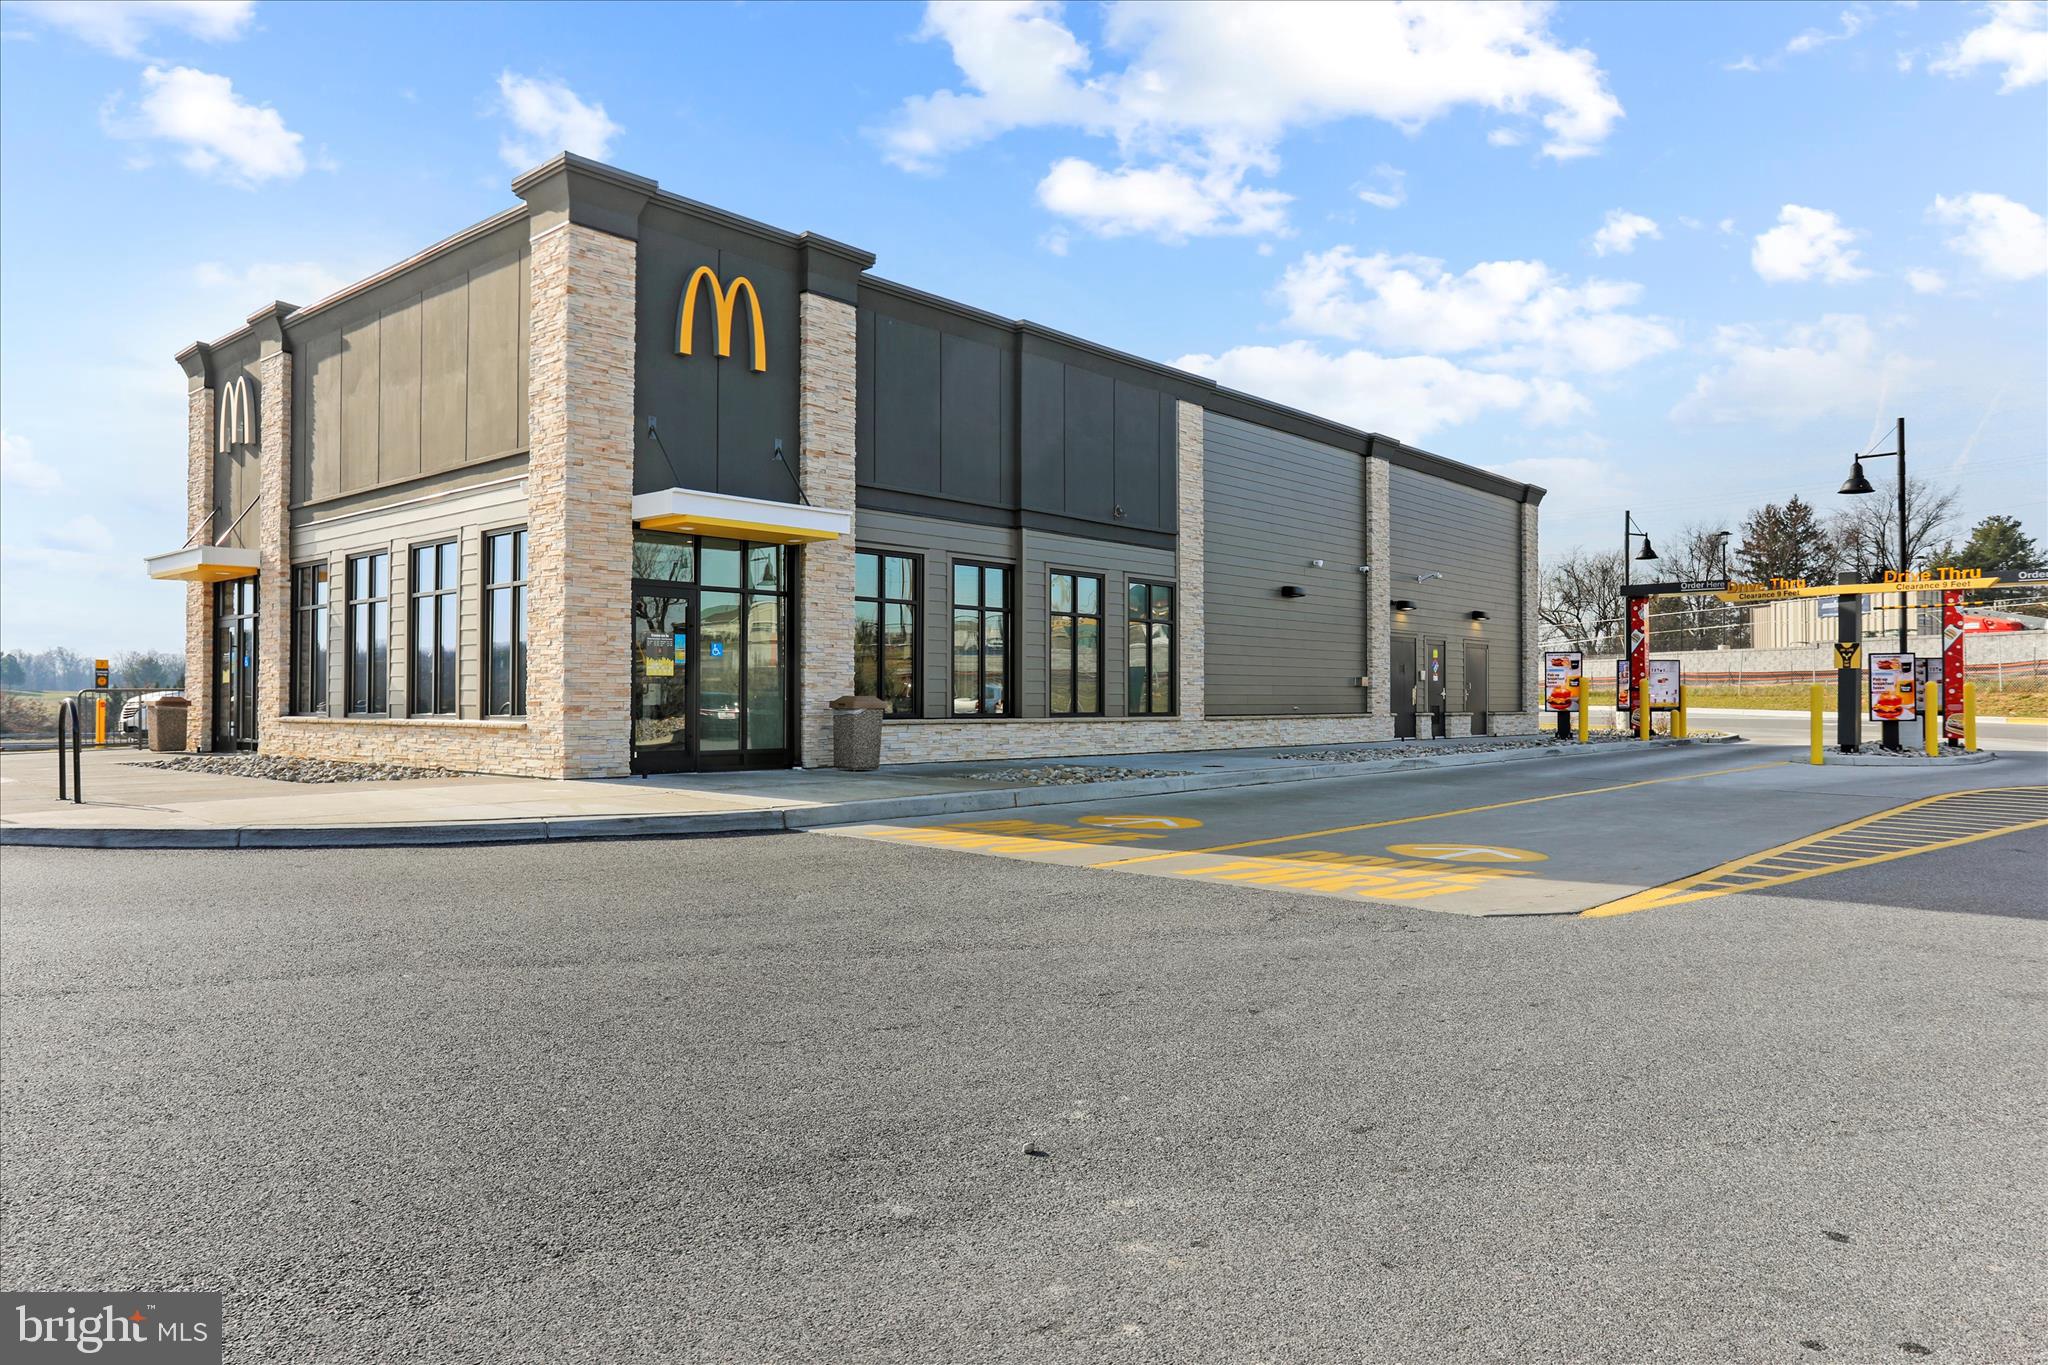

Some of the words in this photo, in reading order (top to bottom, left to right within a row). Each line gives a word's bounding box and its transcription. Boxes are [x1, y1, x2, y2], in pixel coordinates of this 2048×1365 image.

[1884, 570, 1931, 583] Drive
[1937, 567, 1981, 580] Thru
[1680, 581, 1704, 590] Order
[1706, 580, 1725, 589] Here
[1727, 581, 1766, 594] Drive
[1770, 577, 1807, 590] Thru
[1896, 582, 1940, 591] Clearance
[1950, 580, 1971, 588] Feet
[1739, 591, 1775, 600] Clearance
[1783, 589, 1801, 597] Feet
[1173, 861, 1481, 899] THRU
